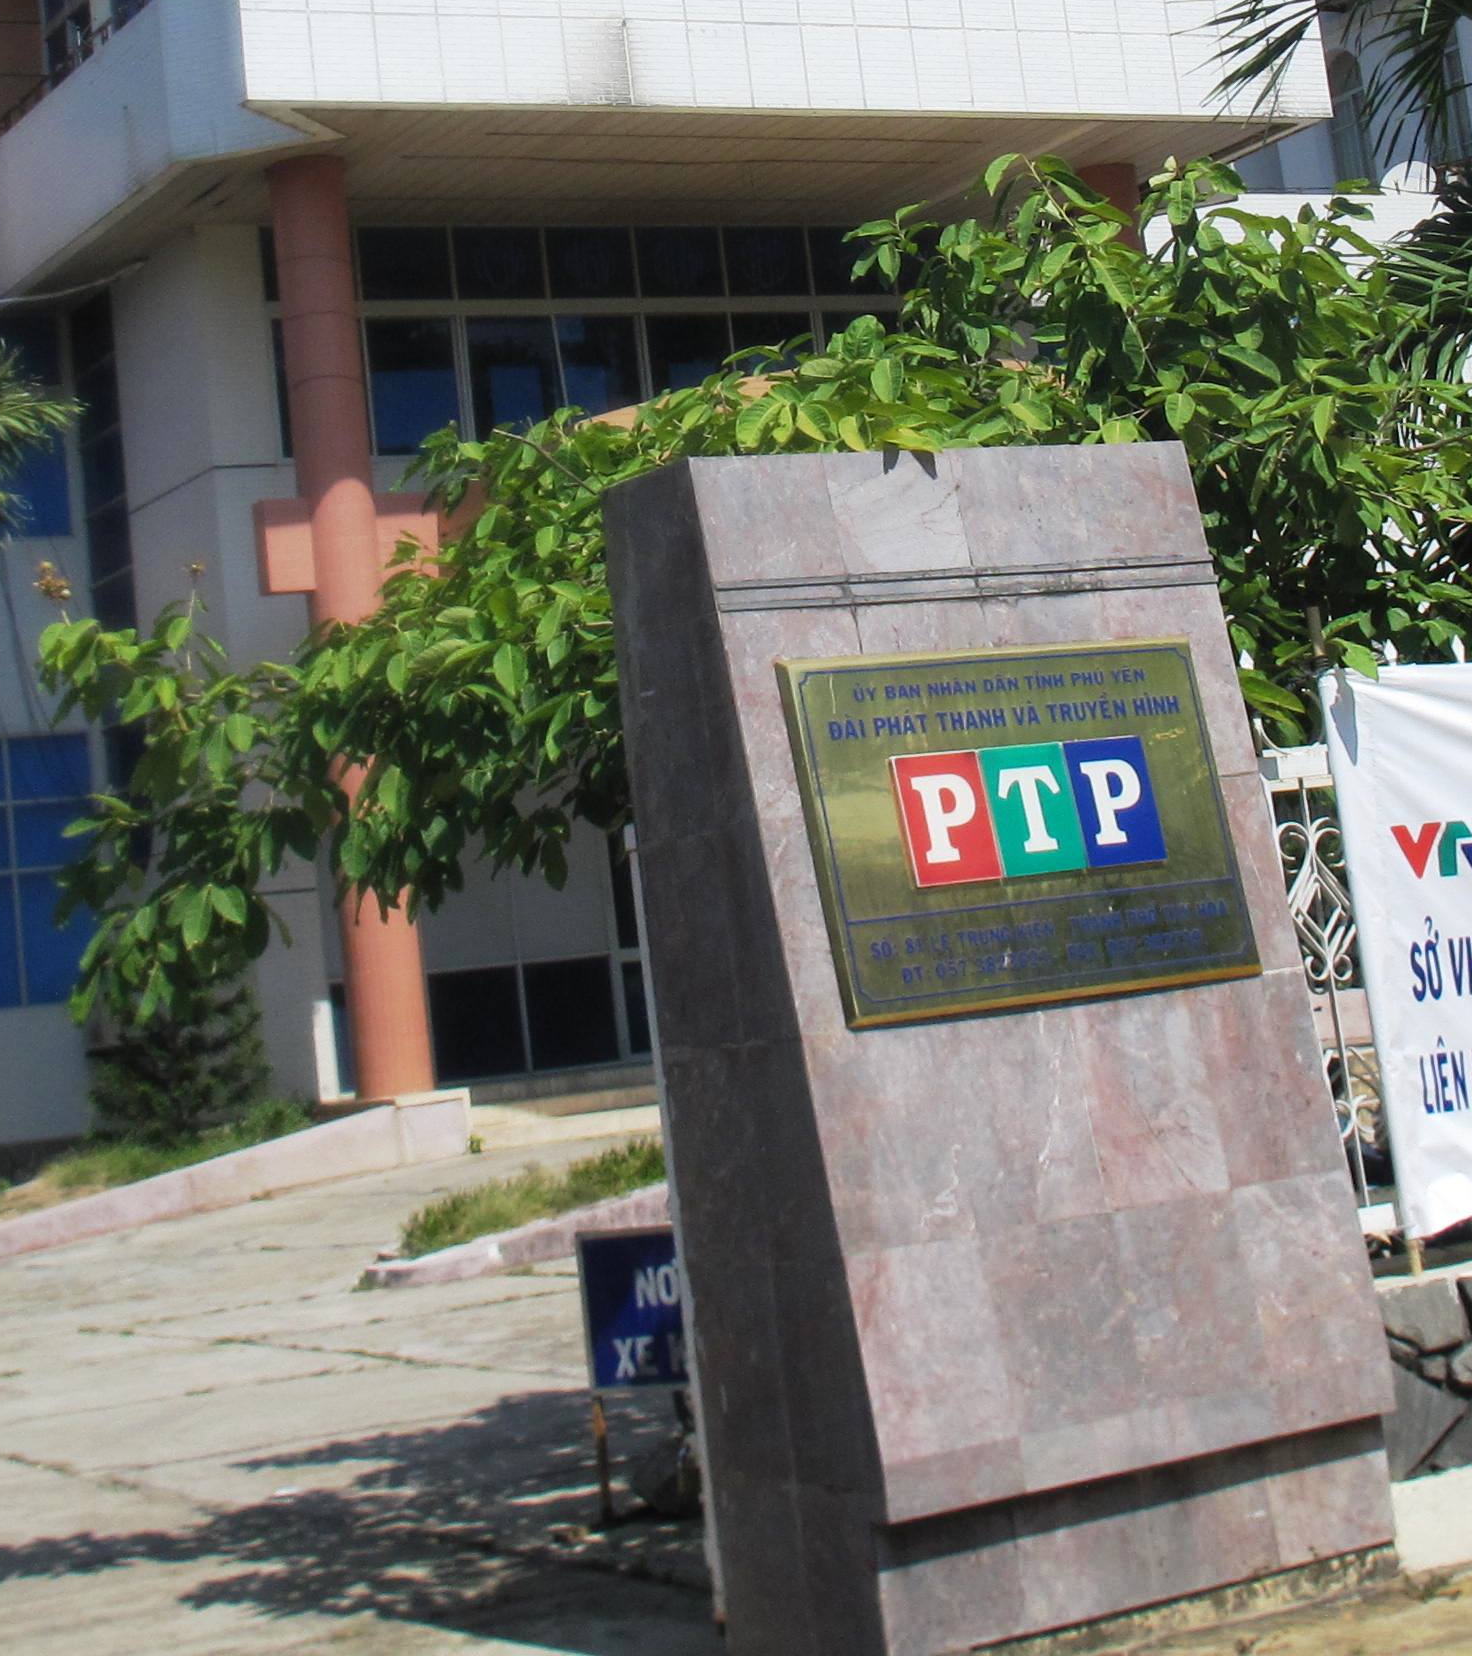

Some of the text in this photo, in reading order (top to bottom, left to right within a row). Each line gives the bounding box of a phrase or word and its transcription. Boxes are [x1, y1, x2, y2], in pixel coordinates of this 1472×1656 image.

[884, 683, 921, 701] BAN
[928, 677, 977, 698] NHÂN
[982, 674, 1019, 693] DÂN
[1023, 670, 1066, 691] TỈNH
[1111, 665, 1146, 684] YÊN
[828, 692, 1181, 741] ĐÀI PHÁT THANH VÀ TRUYỀN HÌNH
[910, 758, 1142, 865] PTP
[1410, 916, 1443, 1002] SỞ
[1419, 1035, 1470, 1114] LIÊN
[613, 1335, 658, 1379] XE
